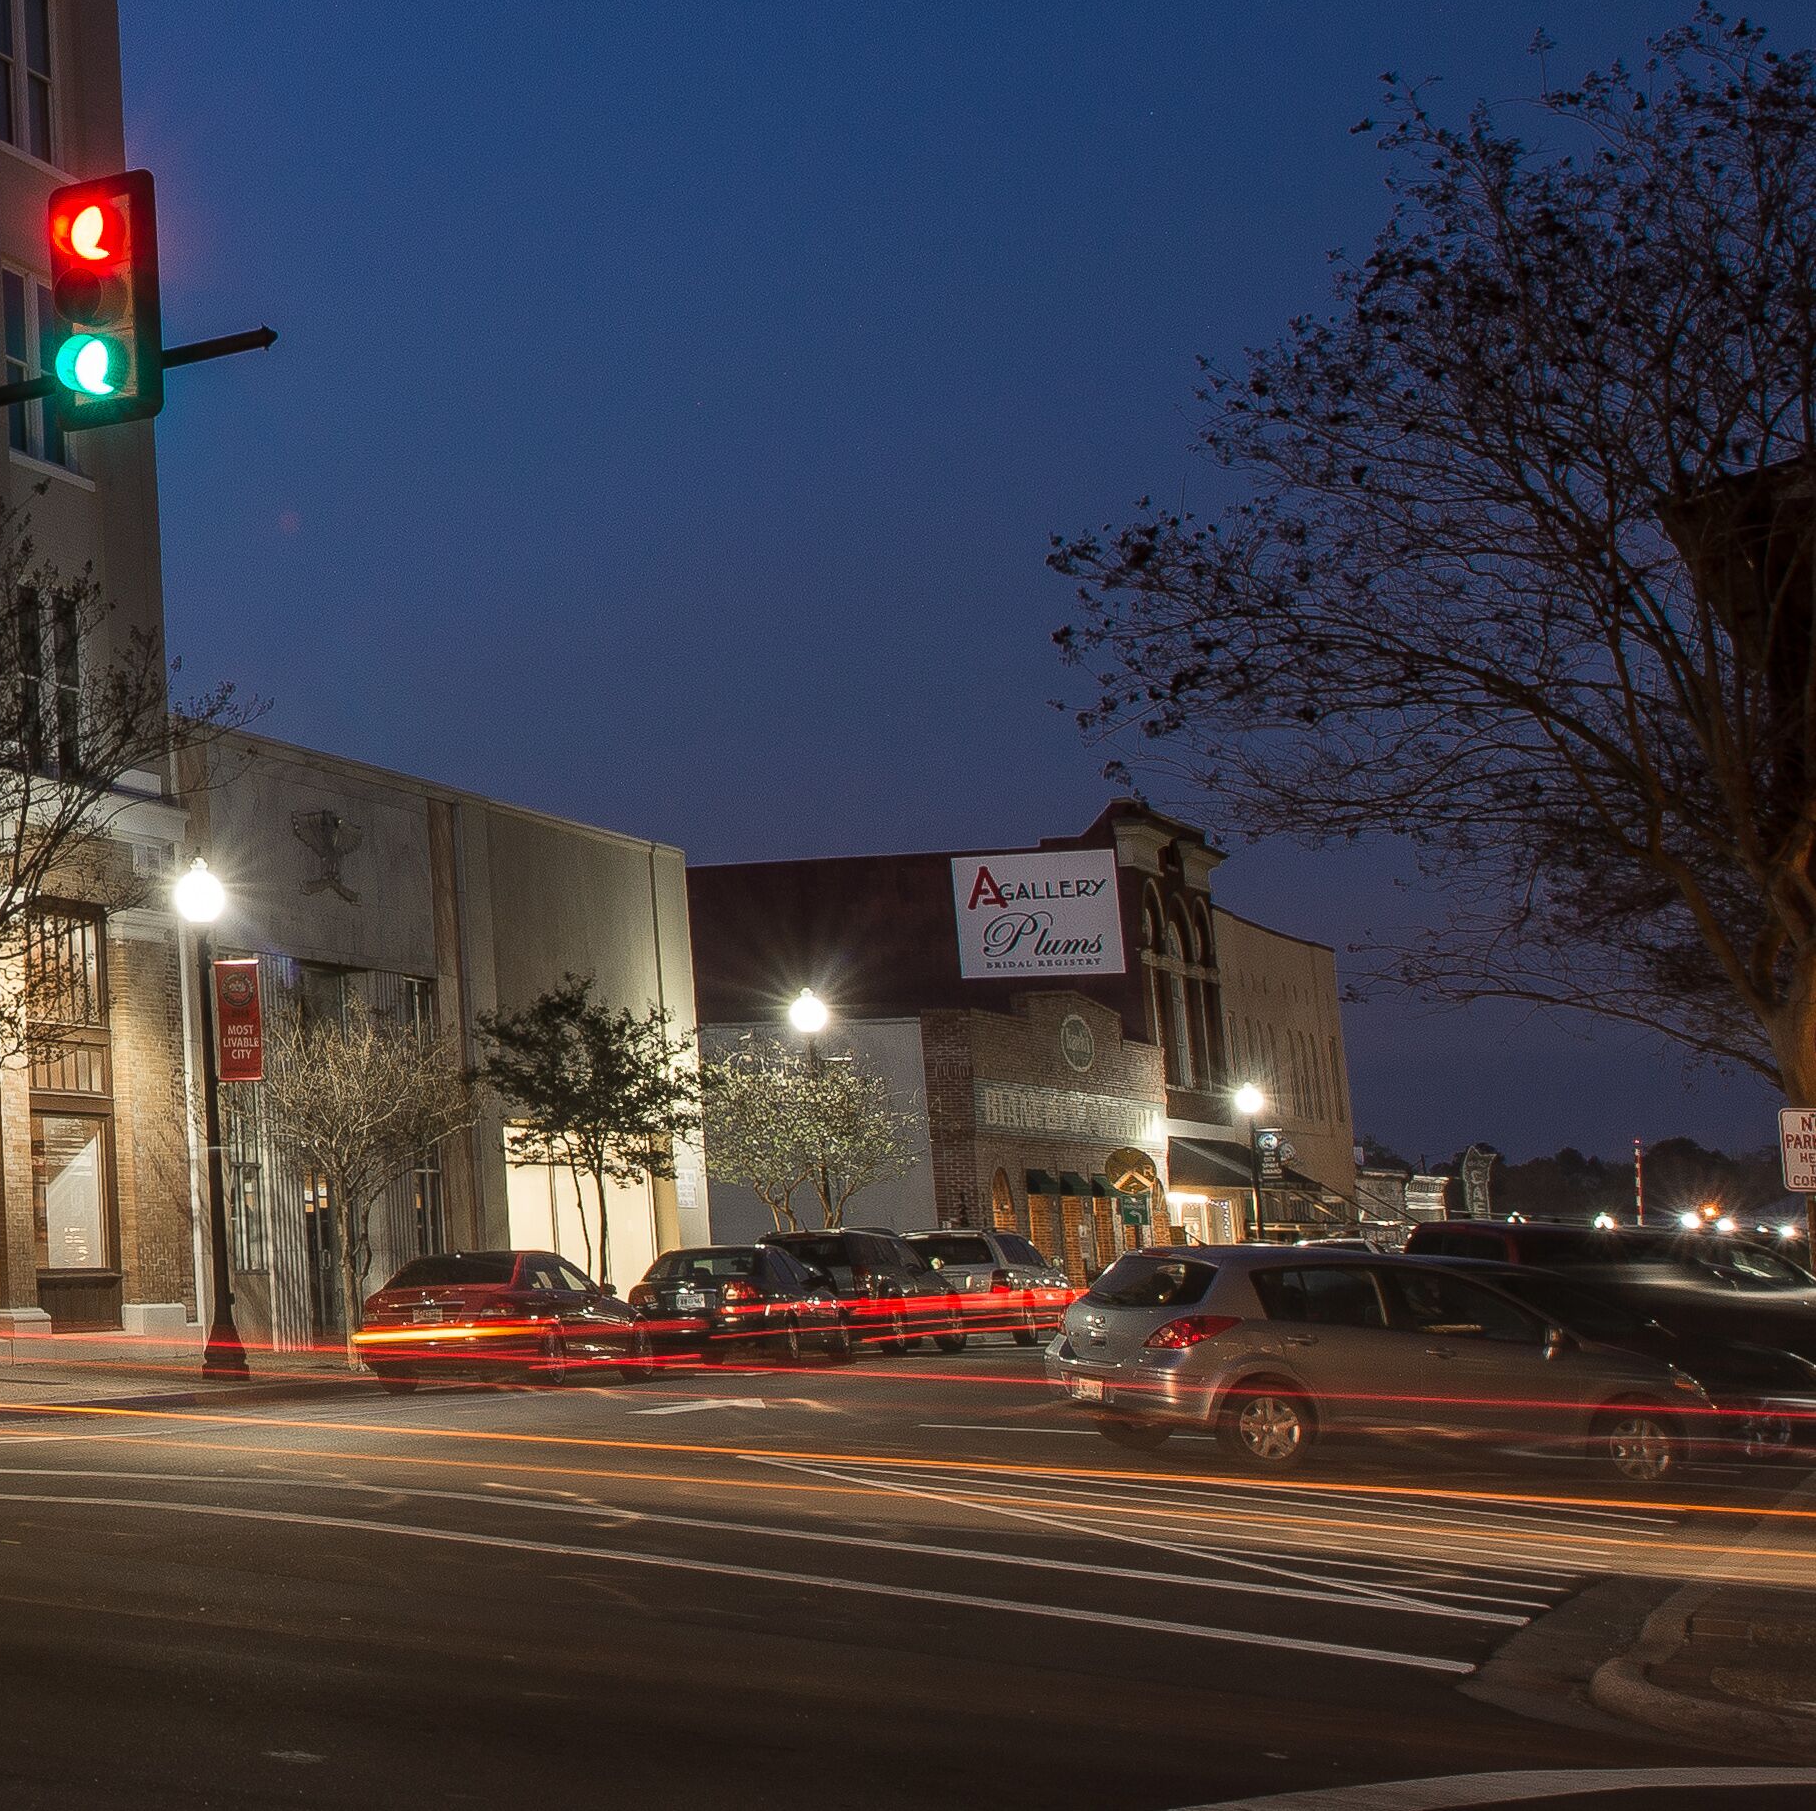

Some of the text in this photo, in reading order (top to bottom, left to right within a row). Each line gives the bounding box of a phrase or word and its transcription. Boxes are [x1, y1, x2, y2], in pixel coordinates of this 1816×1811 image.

[983, 910, 1103, 958] Plums
[986, 957, 1103, 969] BRIDAL REGISTRY
[227, 1024, 254, 1035] MOST
[222, 1036, 260, 1048] LIVABLE
[231, 1048, 252, 1060] CITY
[1801, 1116, 1816, 1131] N
